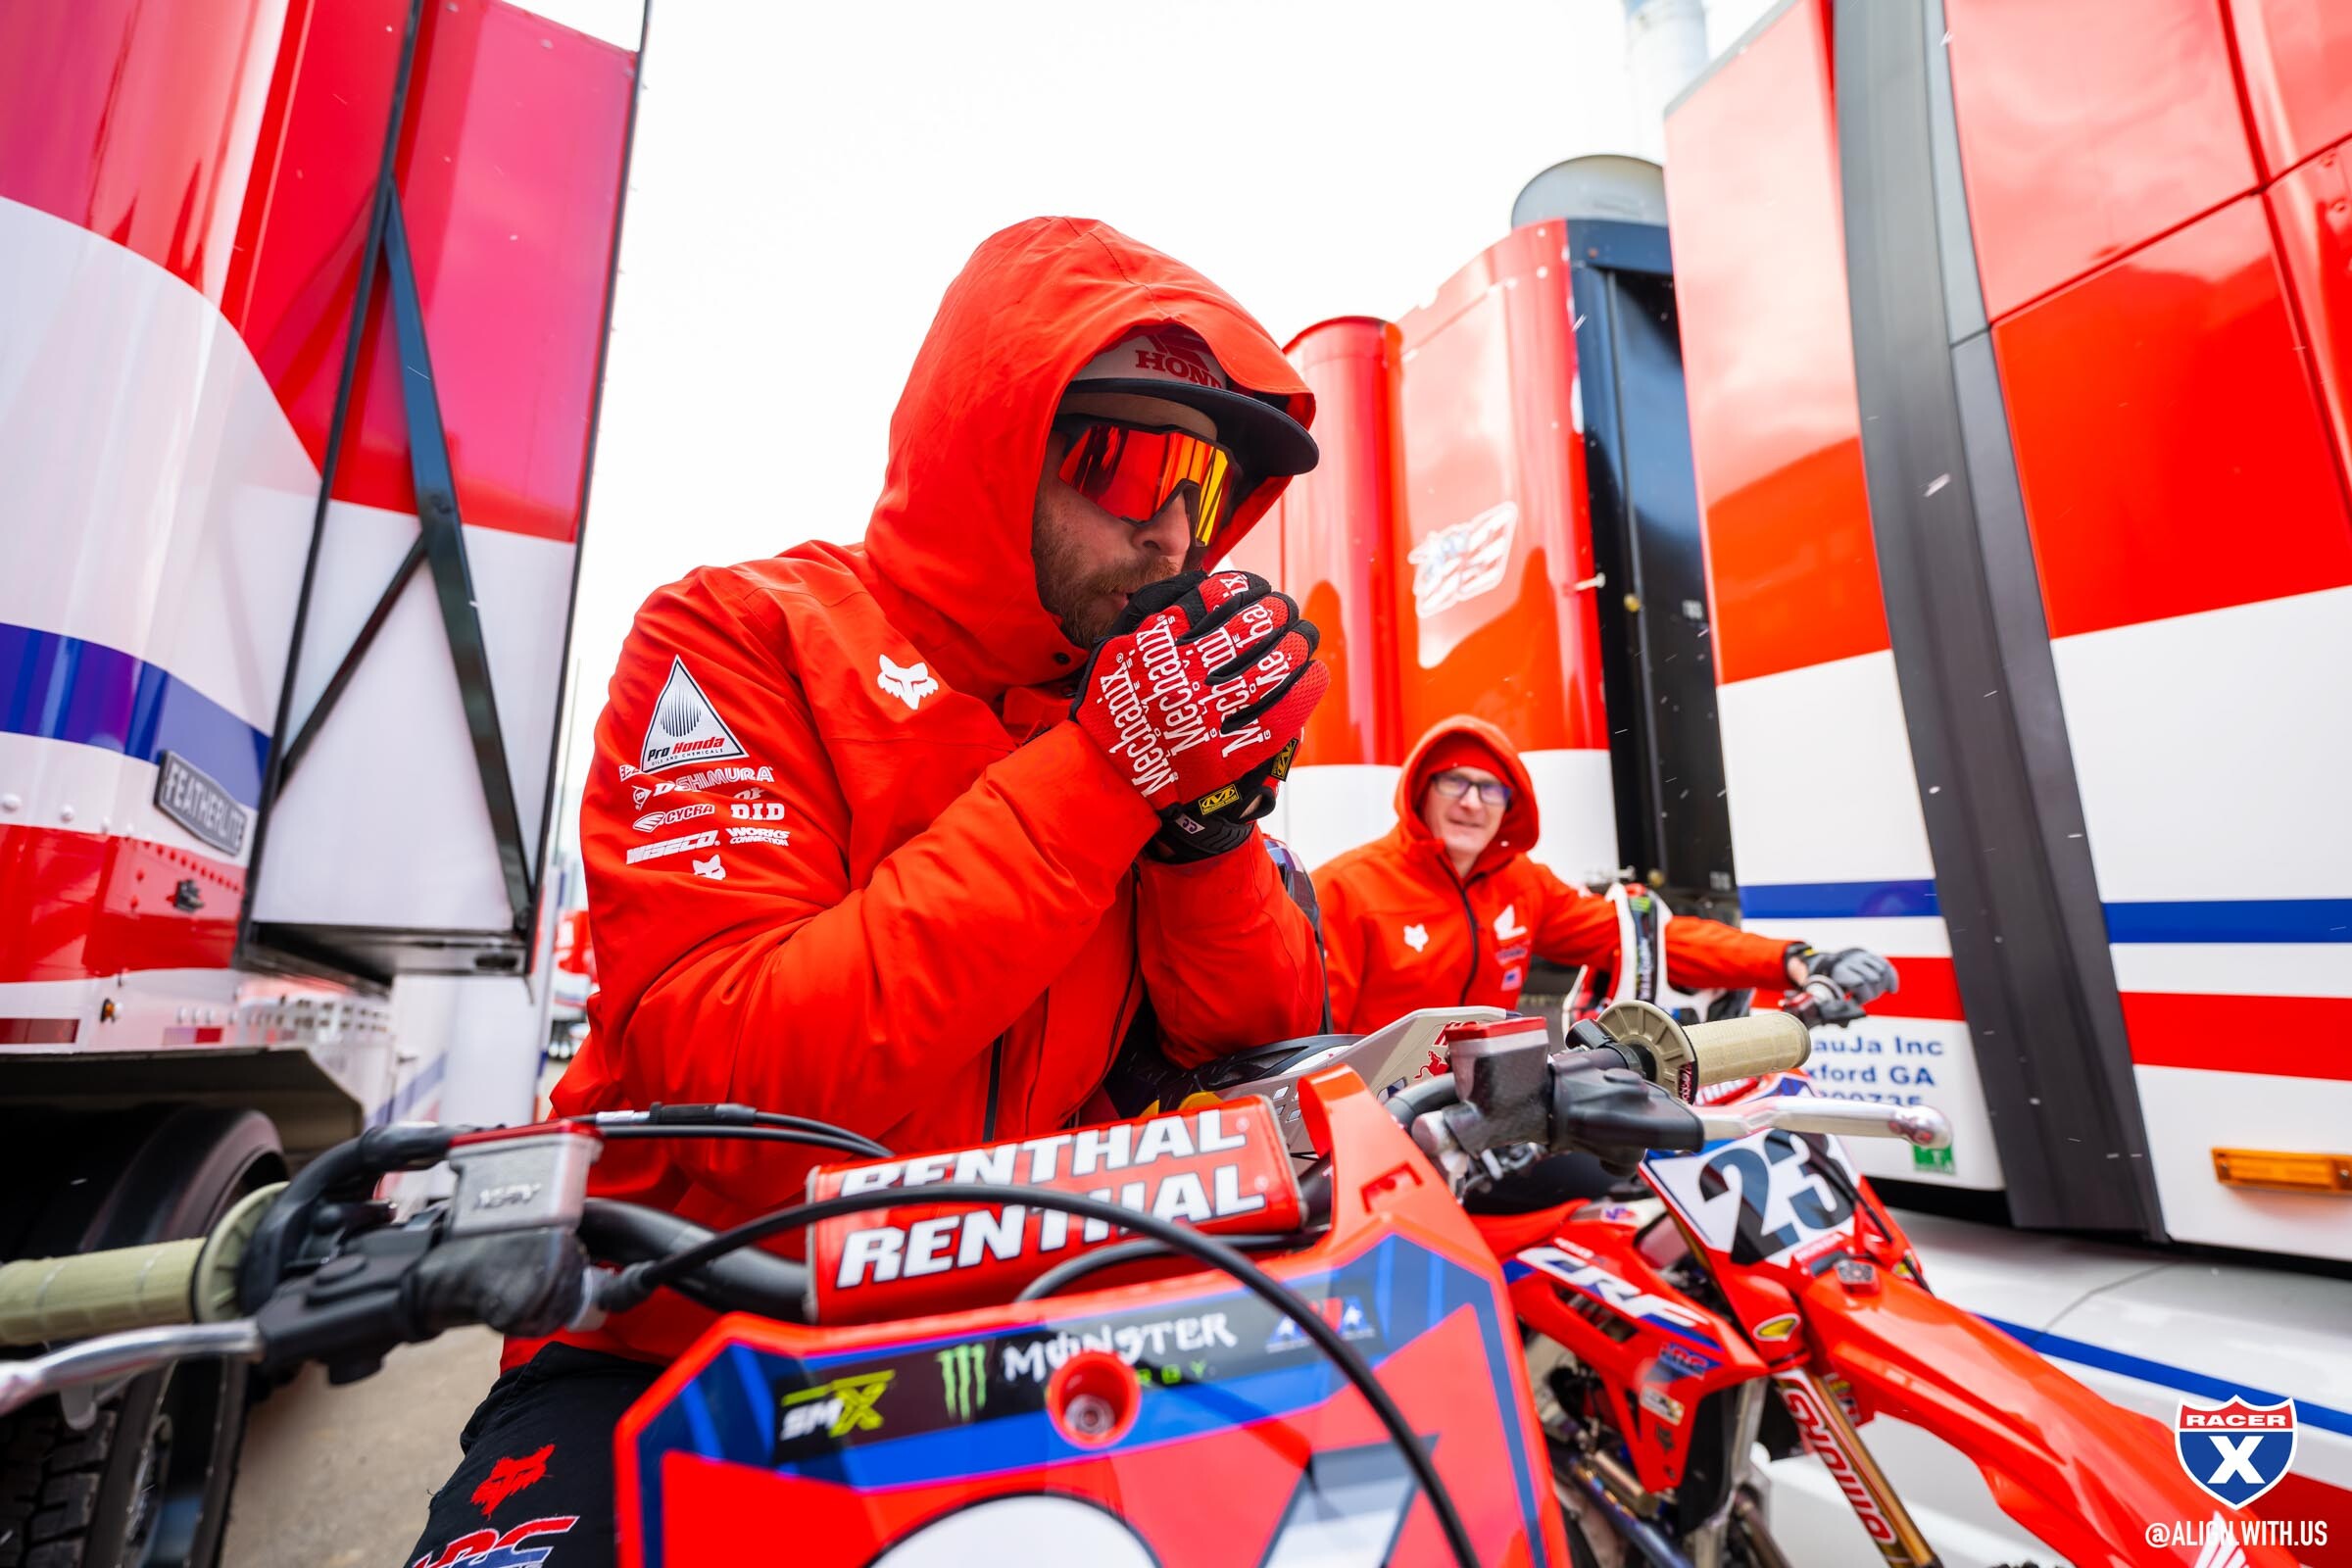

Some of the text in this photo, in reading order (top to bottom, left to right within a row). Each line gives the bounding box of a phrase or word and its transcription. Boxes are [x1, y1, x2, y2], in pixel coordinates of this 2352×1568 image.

[1129, 614, 1211, 757] Mechanix
[647, 737, 725, 762] Pro Honda
[1097, 653, 1176, 798] Mechanix
[682, 748, 724, 759] CHEMICALS
[673, 765, 774, 793] SHIMURA
[165, 761, 244, 848] FEATHERLITE
[666, 804, 714, 823] CYCRA
[725, 827, 791, 839] WORKS
[729, 836, 790, 847] CONNECTION
[1813, 1036, 1944, 1056] auJa Inc
[1806, 1064, 1936, 1086] xford GA
[840, 1108, 1248, 1198] RENTHAL
[1698, 1129, 1856, 1265] 23
[1516, 1246, 1710, 1328] CRF
[1003, 1311, 1239, 1383] MONSTER
[781, 1369, 895, 1441] SMX
